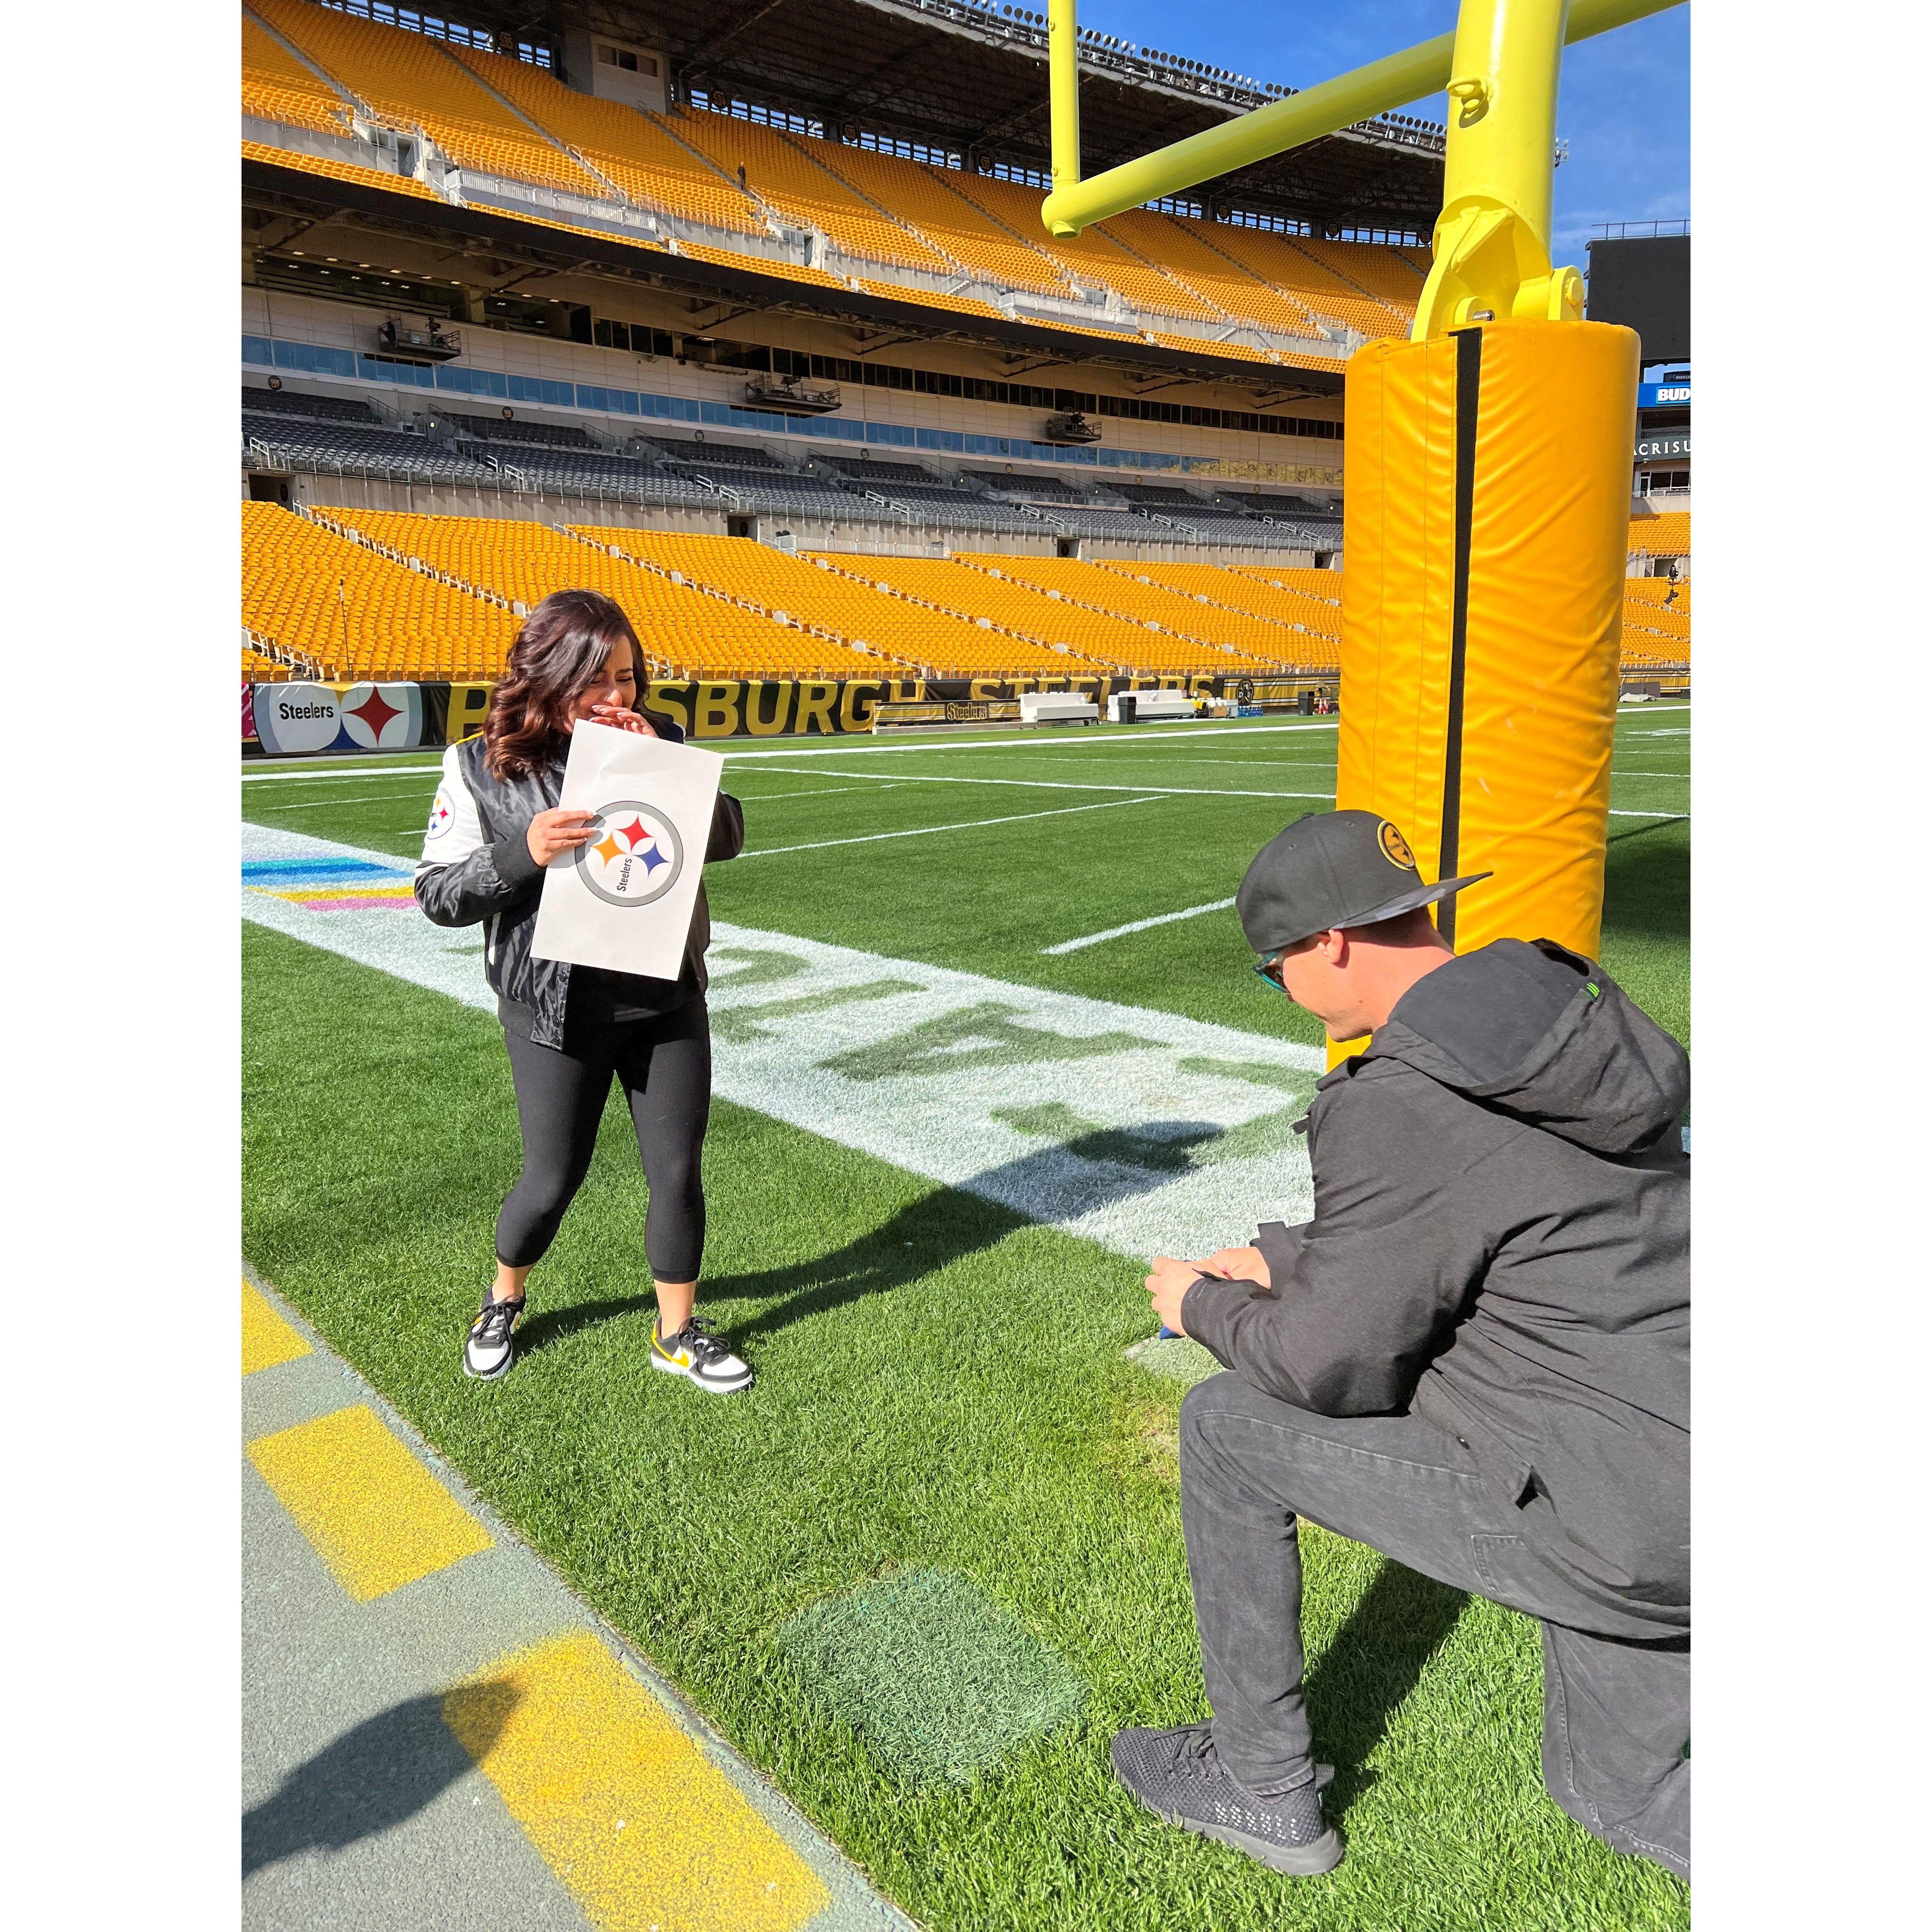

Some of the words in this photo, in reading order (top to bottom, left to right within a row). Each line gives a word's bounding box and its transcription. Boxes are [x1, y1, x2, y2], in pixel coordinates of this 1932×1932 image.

[279, 702, 334, 720] Steelers
[946, 702, 987, 720] Steelers
[617, 858, 632, 892] Steelers
